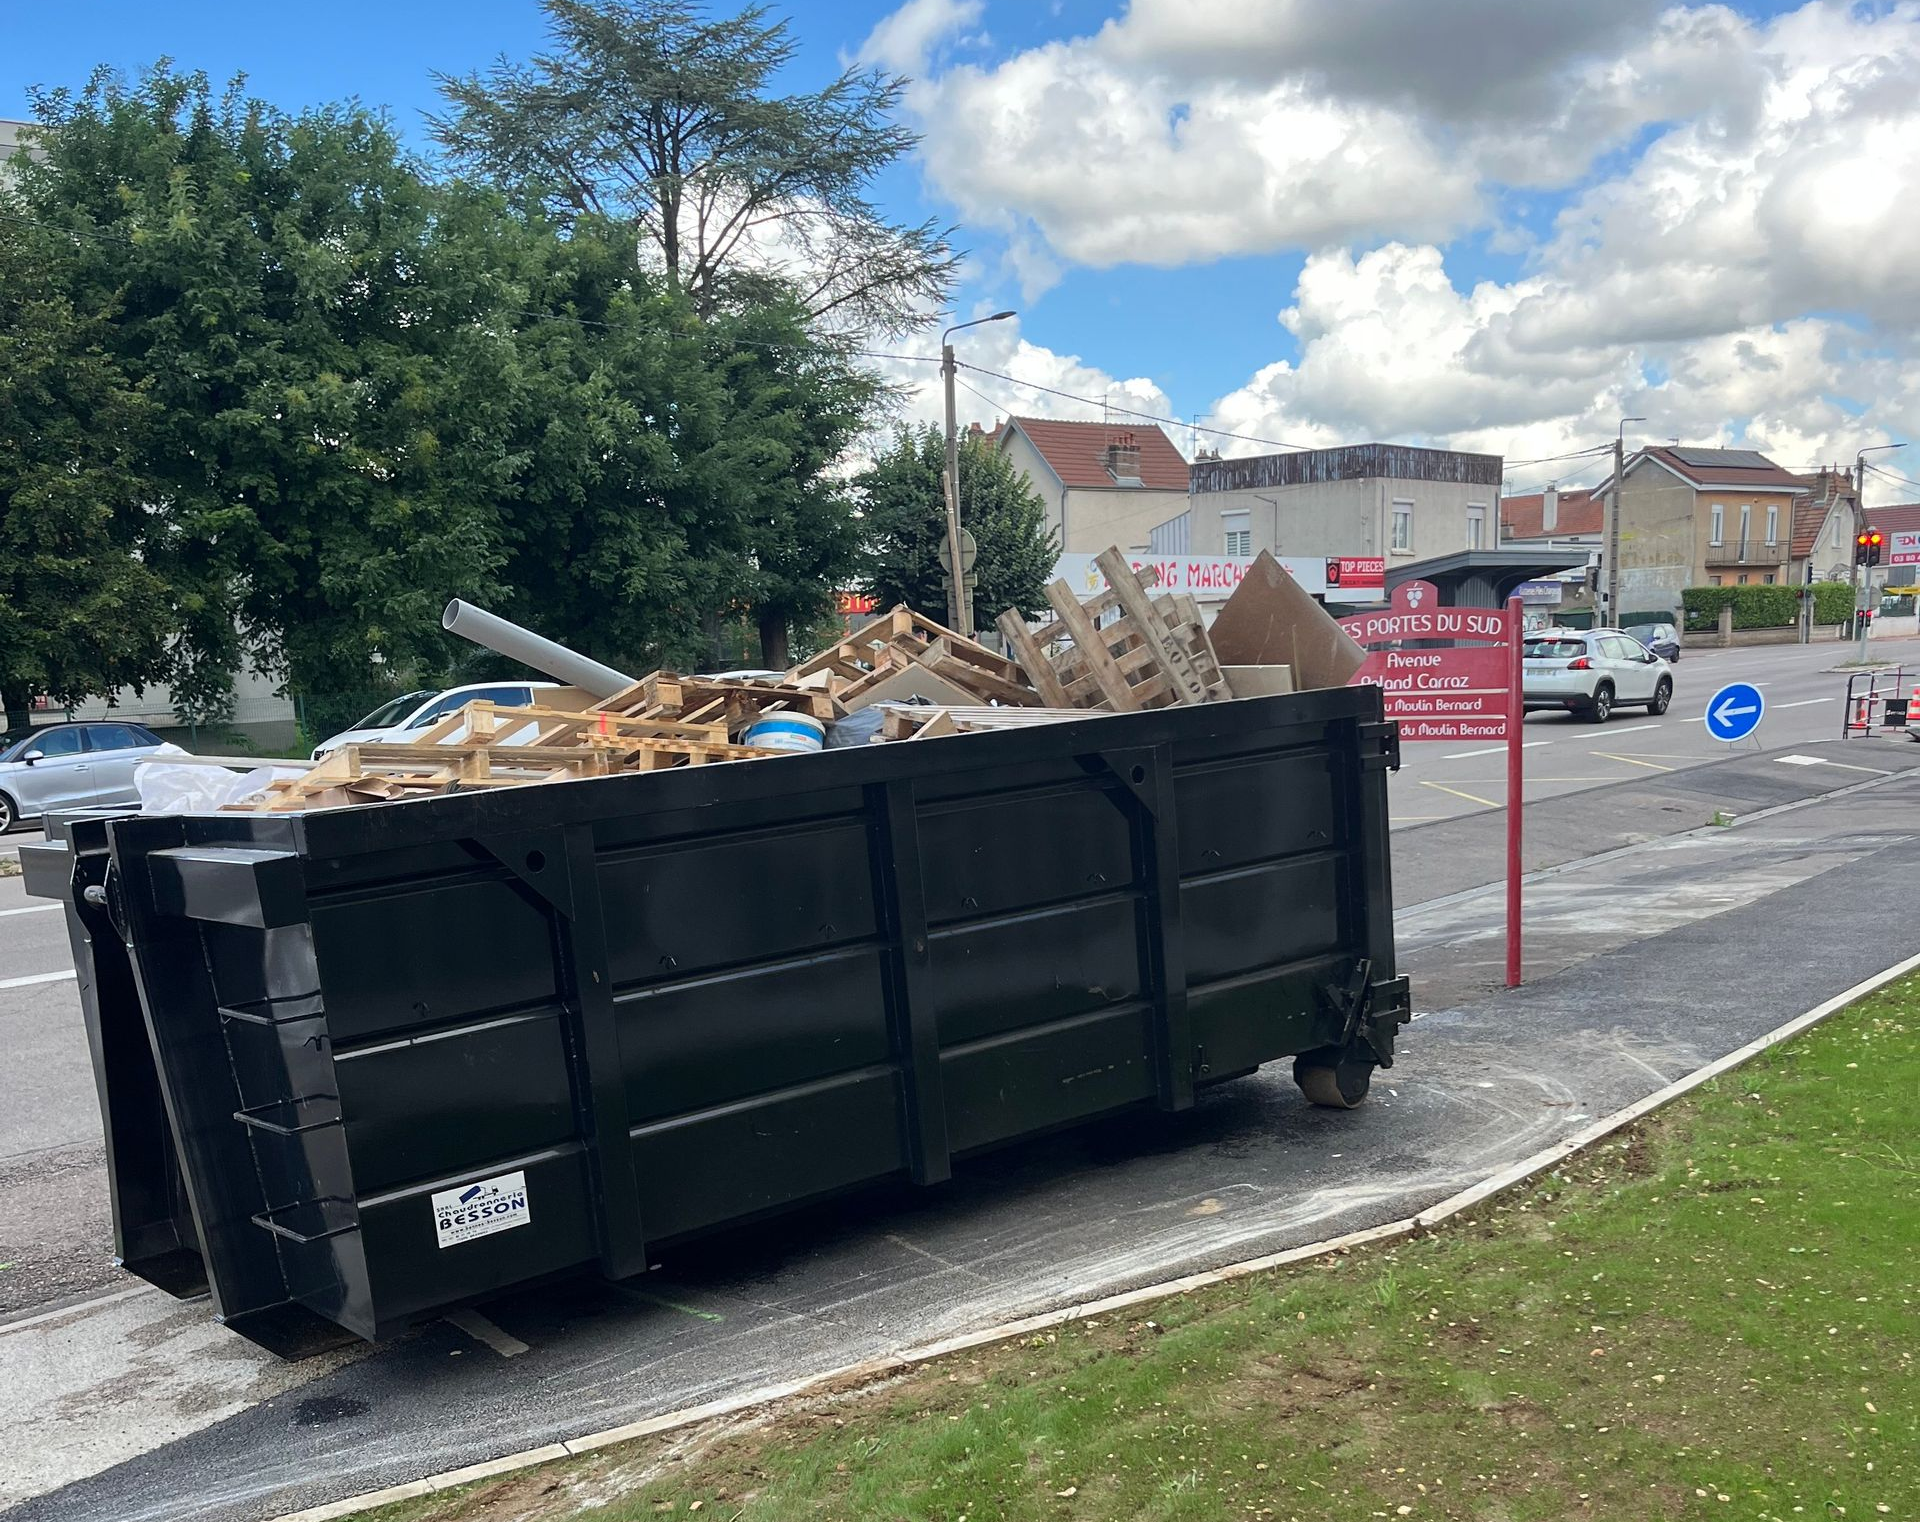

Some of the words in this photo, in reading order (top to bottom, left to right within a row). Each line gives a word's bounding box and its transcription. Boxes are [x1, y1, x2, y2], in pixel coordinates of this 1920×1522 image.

[1340, 560, 1356, 573] TOP
[1357, 560, 1384, 573] PIECES
[1341, 622, 1362, 639] ES
[1367, 614, 1432, 637] PORTES
[1437, 614, 1462, 632] DU
[1466, 615, 1502, 635] SUD
[1387, 652, 1442, 668] Avenue
[1417, 673, 1470, 689] Carraz
[1395, 699, 1433, 712] Moulin
[1436, 698, 1482, 711] Bernard
[1400, 724, 1416, 736] du
[1418, 723, 1457, 736] Moulin
[1460, 722, 1506, 736] Bernard
[438, 1191, 524, 1218] Chaudronnerie
[440, 1197, 526, 1231] BESSON
